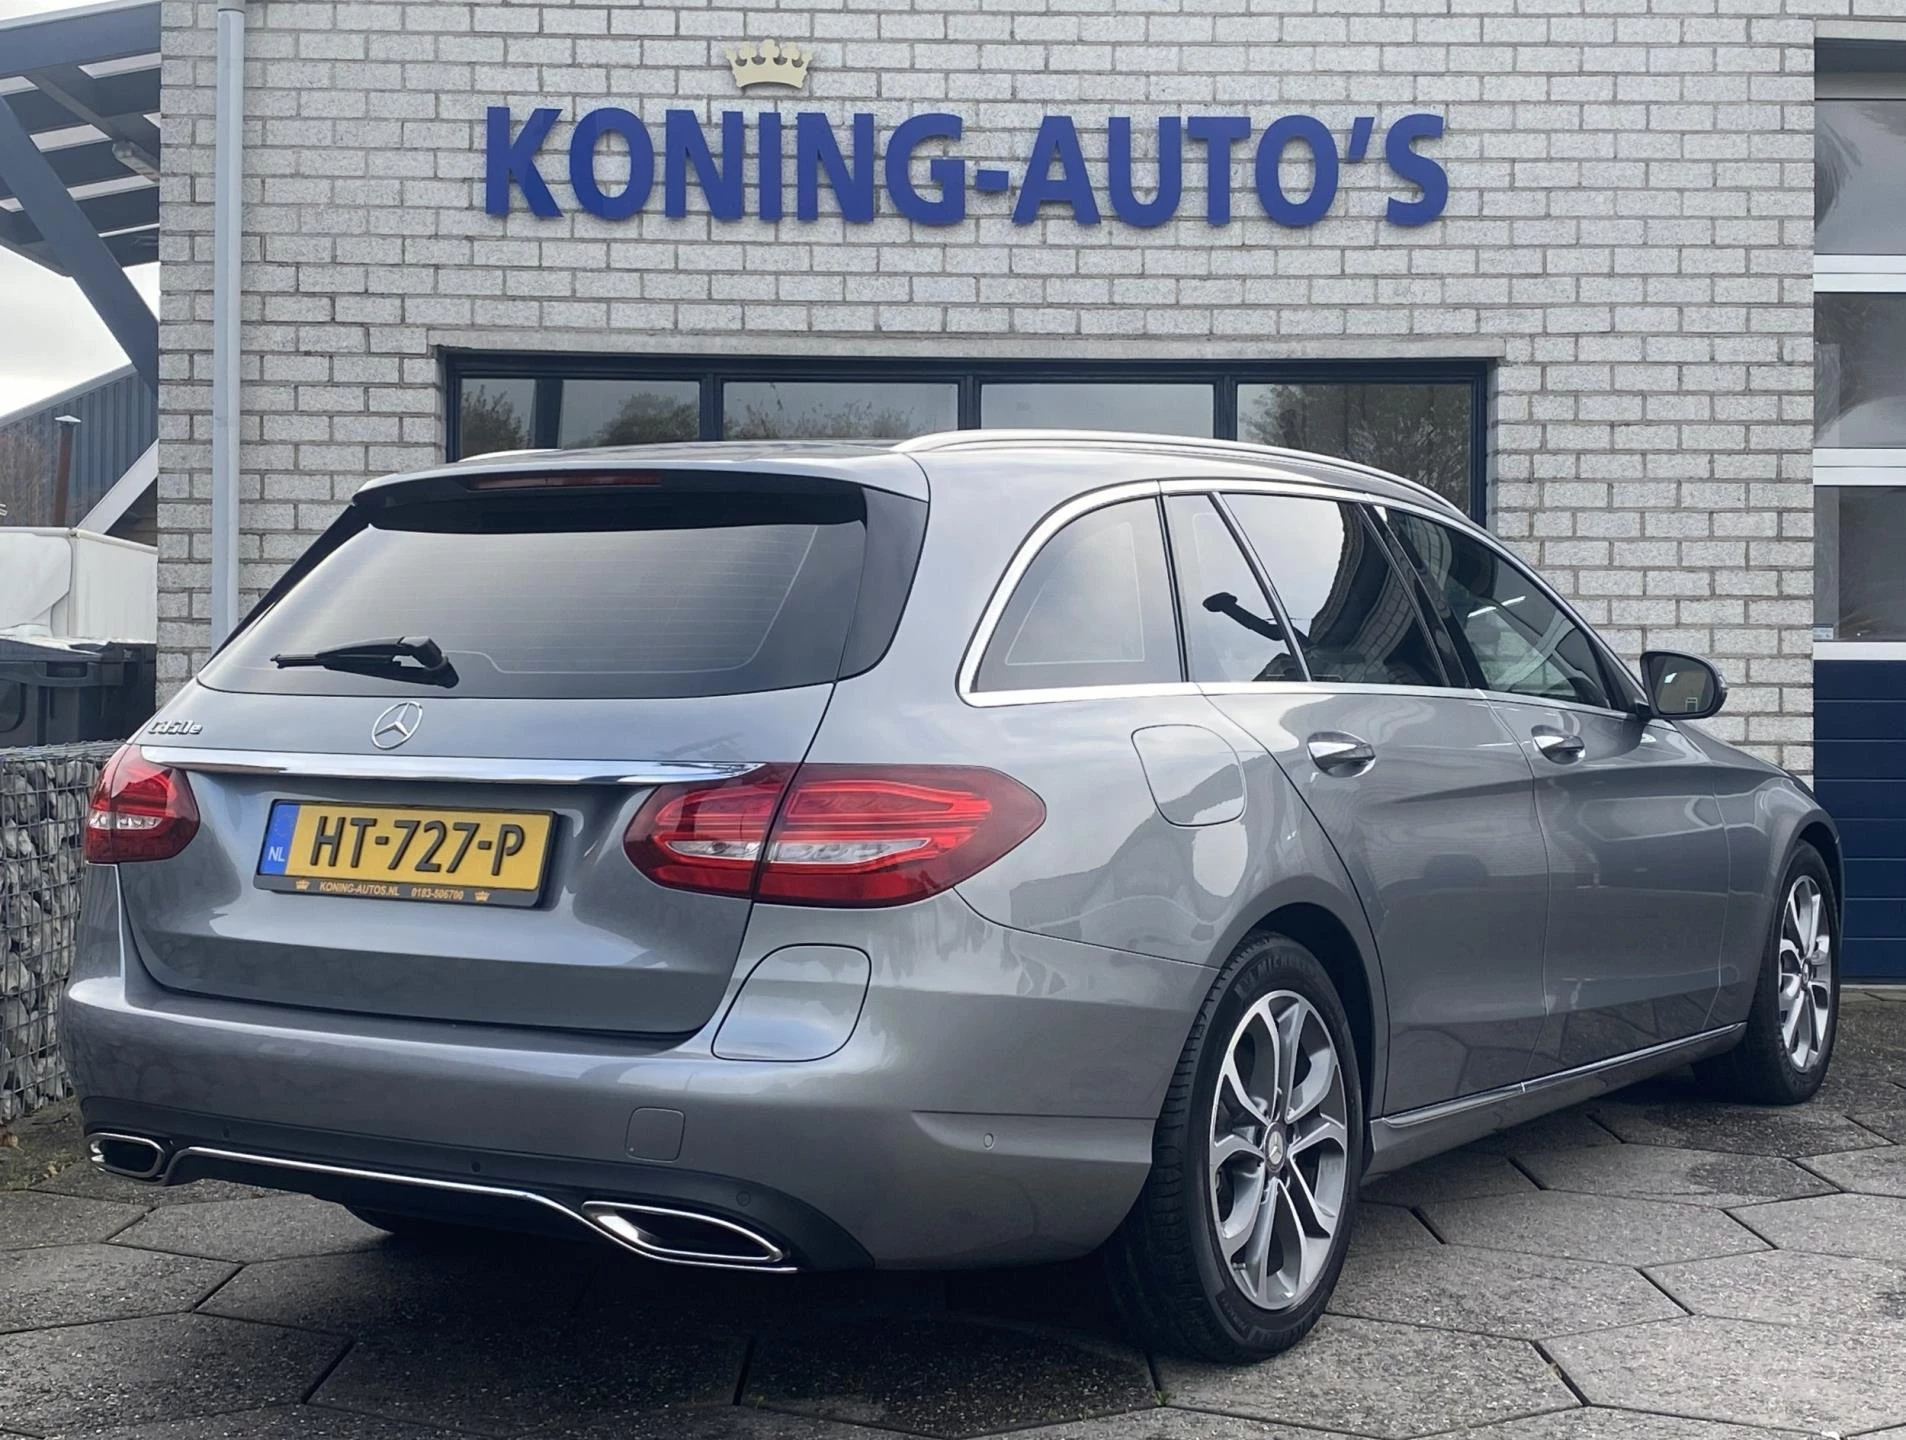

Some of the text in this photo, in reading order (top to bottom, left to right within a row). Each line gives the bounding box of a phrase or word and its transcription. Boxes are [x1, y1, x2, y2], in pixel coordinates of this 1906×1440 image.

[486, 108, 1446, 226] KONING-AUTO'S
[267, 845, 286, 862] NL
[309, 815, 526, 877] HT-727-P
[319, 880, 401, 897] KONING-AUTOS.NL
